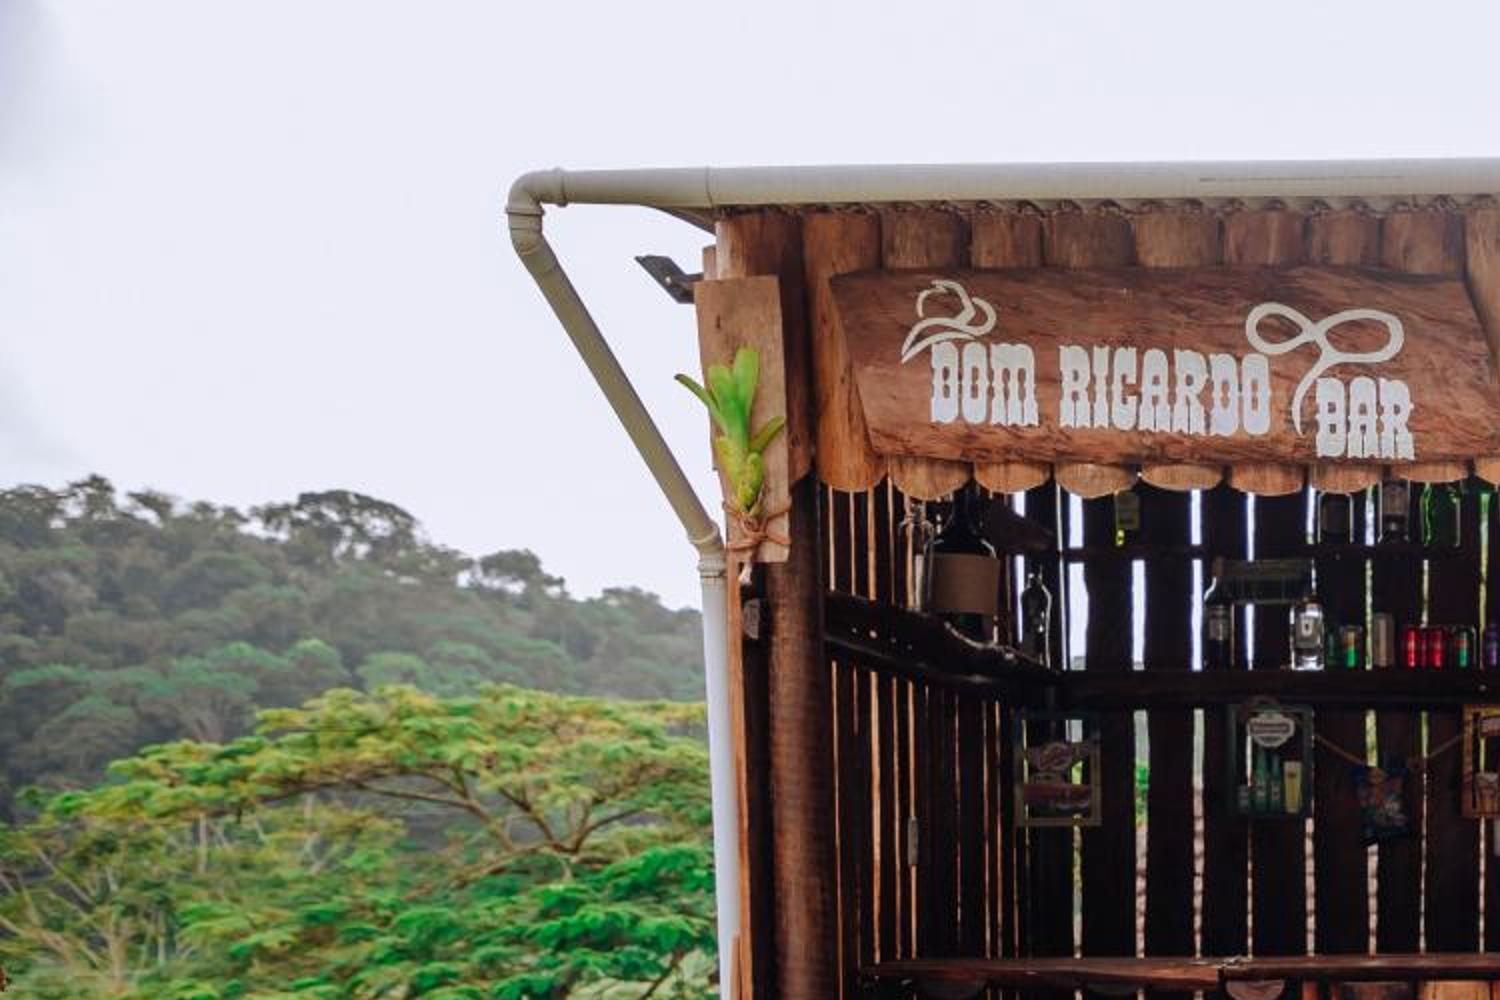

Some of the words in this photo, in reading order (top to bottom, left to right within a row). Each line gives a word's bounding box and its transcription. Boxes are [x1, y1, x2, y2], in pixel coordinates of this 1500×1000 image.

[929, 341, 1040, 427] DOM
[1058, 345, 1272, 437] RICARDO
[1315, 376, 1416, 461] BAR
